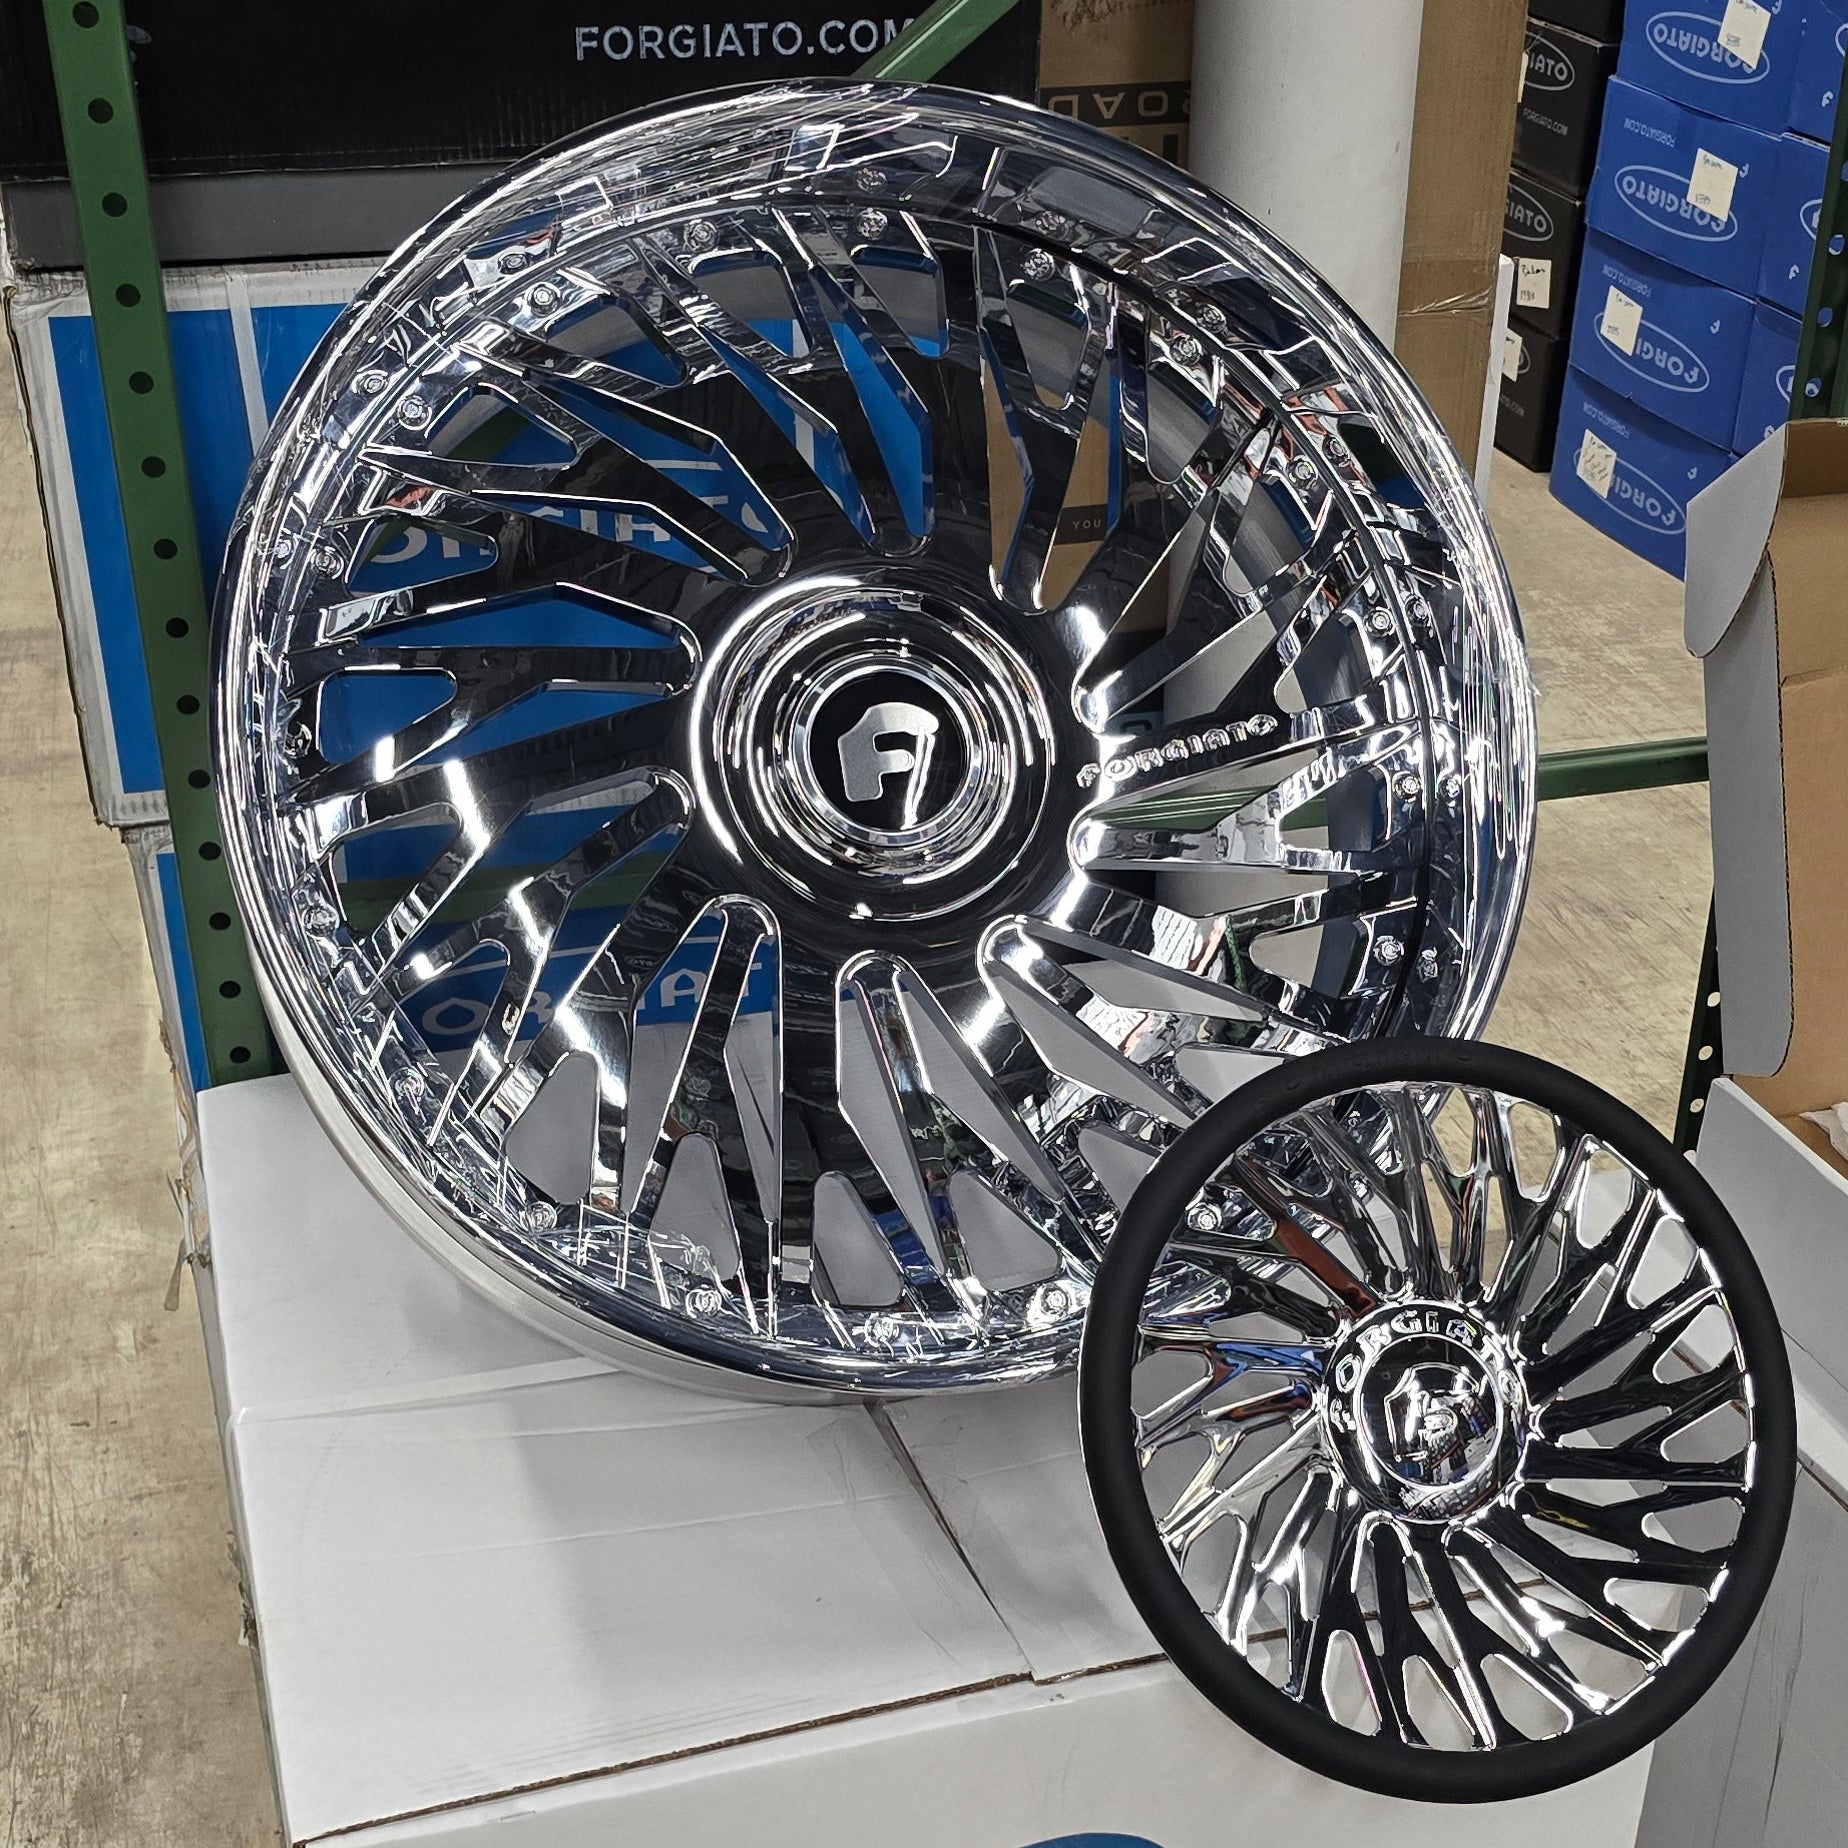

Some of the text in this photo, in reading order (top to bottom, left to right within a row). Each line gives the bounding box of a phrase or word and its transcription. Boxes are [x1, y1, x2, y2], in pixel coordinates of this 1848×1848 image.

[1529, 52, 1568, 81] IATO
[1653, 23, 1753, 74] ORGIATO
[1507, 201, 1547, 233] IATO
[1636, 337, 1700, 384] FORGI
[1611, 472, 1677, 526] FORGI
[1072, 518, 1101, 530] YOU
[1076, 714, 1278, 788] FORGIATO
